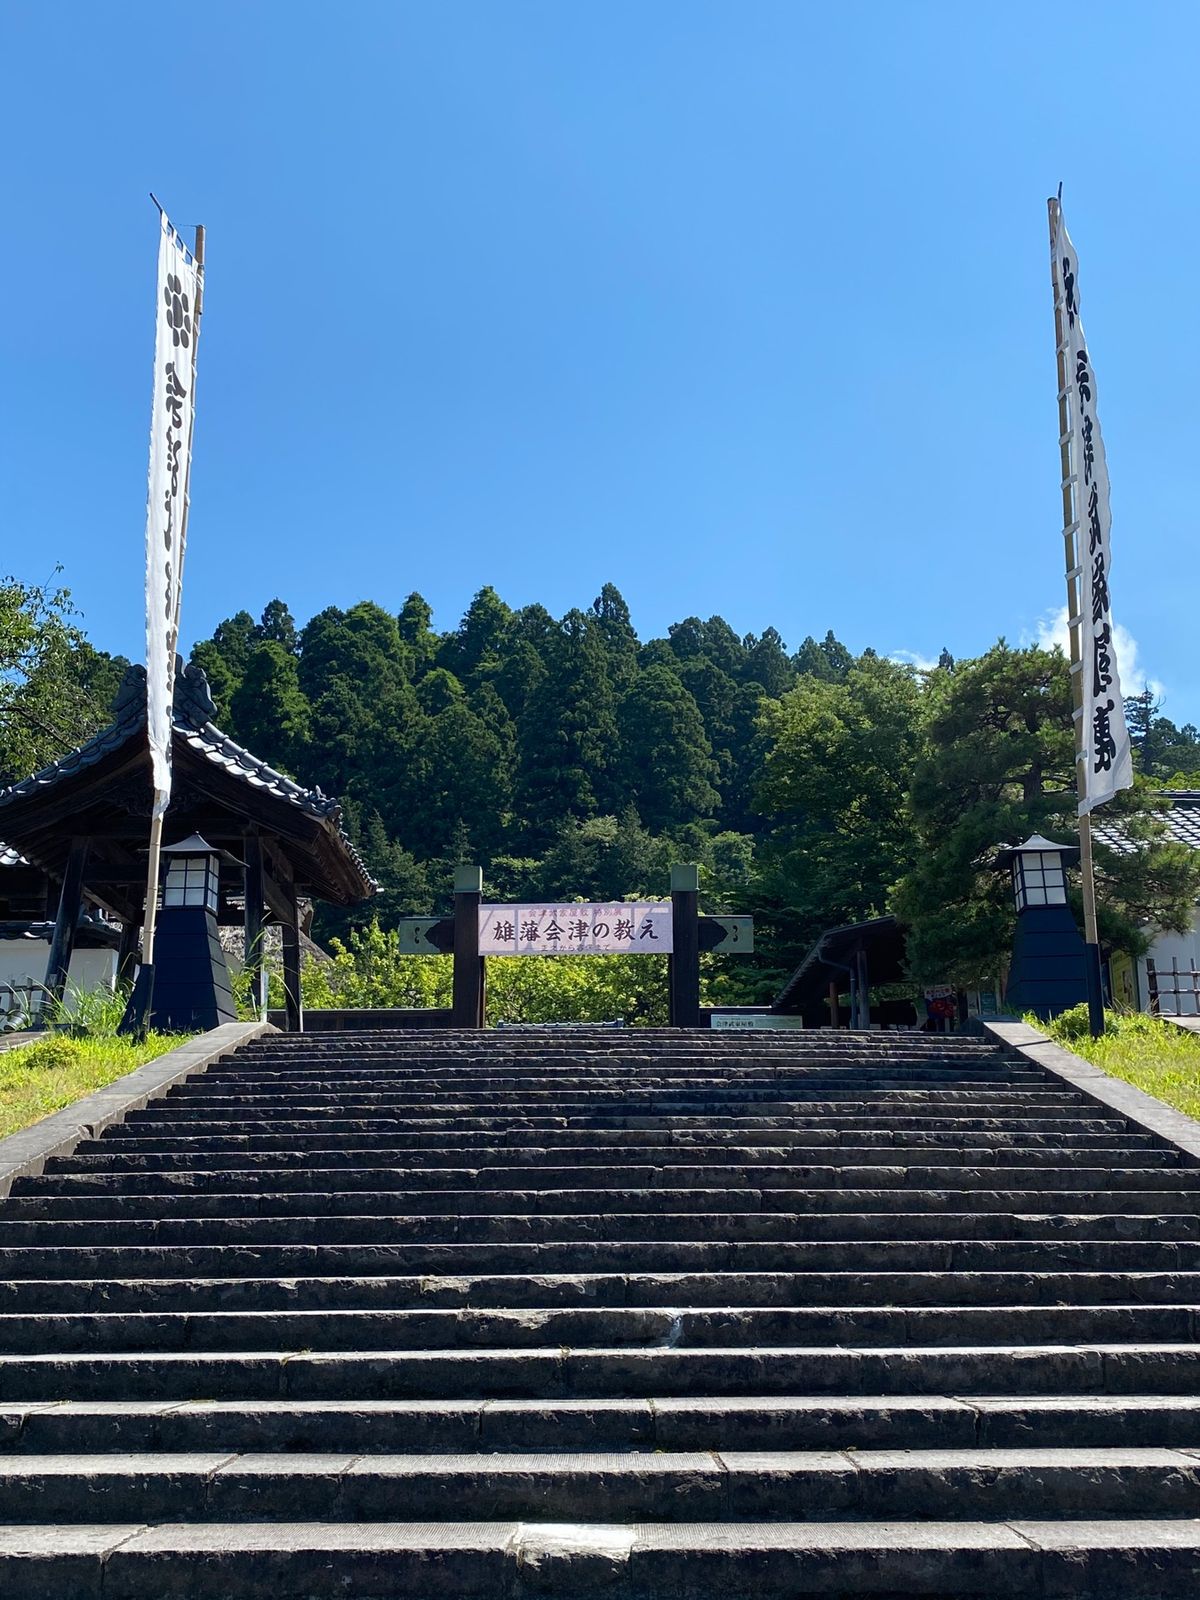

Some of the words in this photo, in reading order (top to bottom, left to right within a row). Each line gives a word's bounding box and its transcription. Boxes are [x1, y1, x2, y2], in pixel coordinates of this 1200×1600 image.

[493, 919, 659, 942] 雄藩会津の教え
